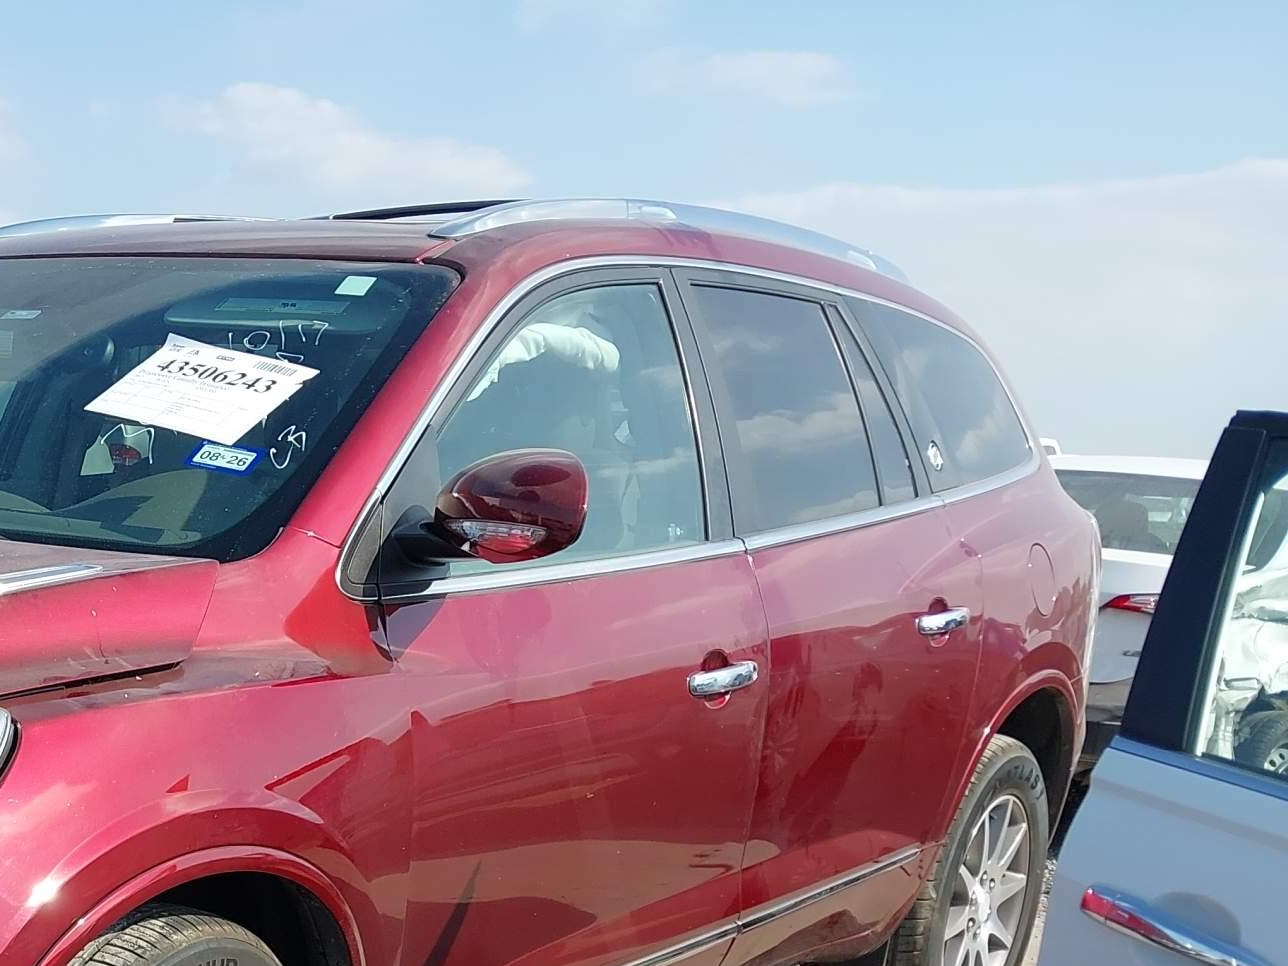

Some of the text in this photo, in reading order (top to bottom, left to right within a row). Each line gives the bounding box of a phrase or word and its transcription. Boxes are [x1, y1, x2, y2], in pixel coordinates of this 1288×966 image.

[156, 359, 278, 393] 43506243
[199, 450, 221, 461] 08
[226, 455, 249, 467] 26
